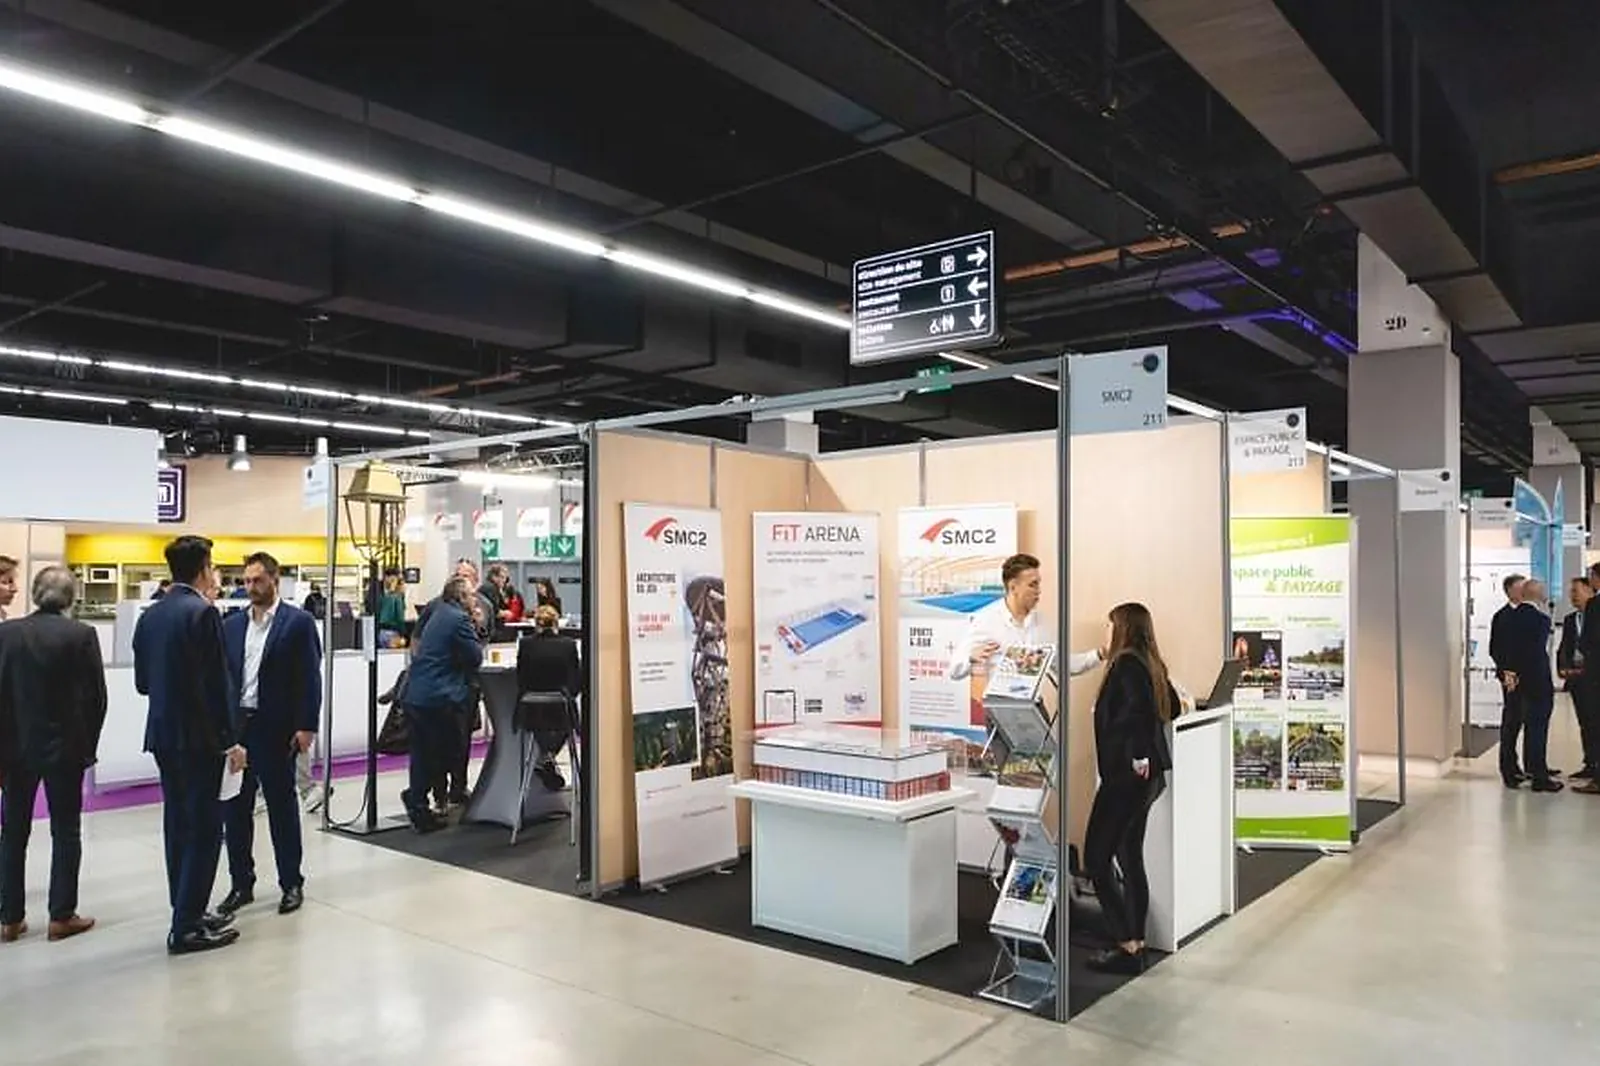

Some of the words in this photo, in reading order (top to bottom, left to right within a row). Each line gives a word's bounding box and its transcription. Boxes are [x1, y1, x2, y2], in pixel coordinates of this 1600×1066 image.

[1101, 389, 1133, 404] SMC2
[1143, 413, 1163, 426] 211
[1268, 431, 1300, 443] PUBLIC
[663, 529, 707, 546] SMC2
[804, 525, 862, 542] ARENA
[941, 529, 997, 545] SMC2
[1272, 563, 1315, 582] public
[1281, 580, 1344, 593] PAYSAGE
